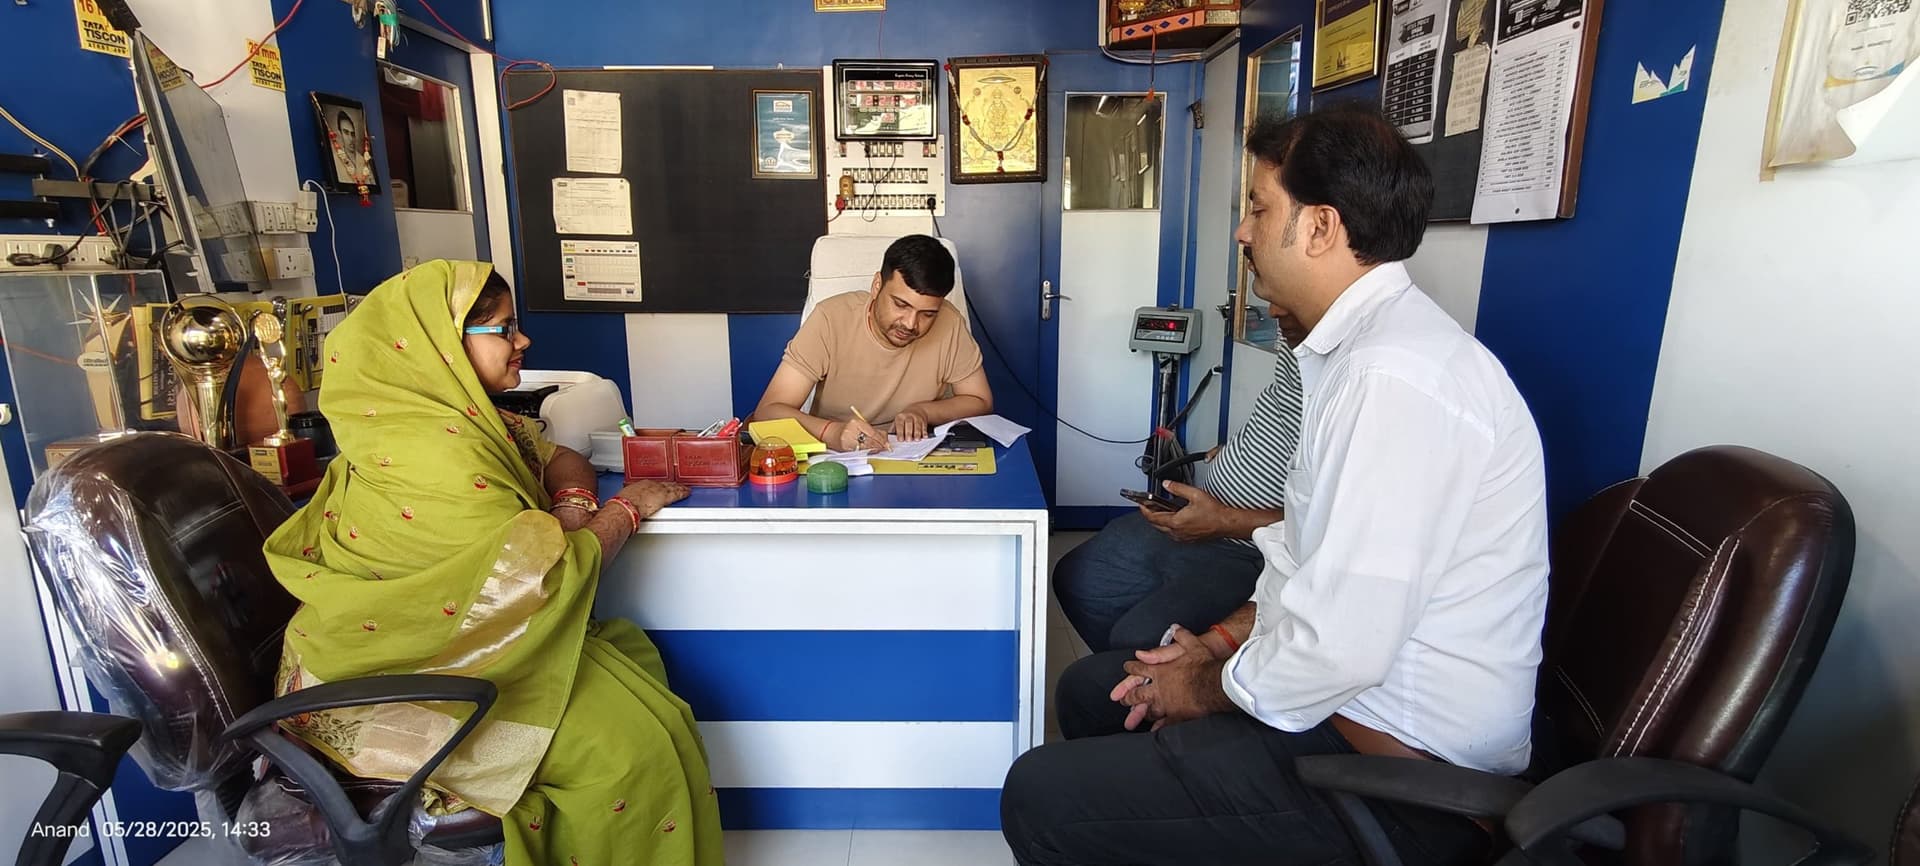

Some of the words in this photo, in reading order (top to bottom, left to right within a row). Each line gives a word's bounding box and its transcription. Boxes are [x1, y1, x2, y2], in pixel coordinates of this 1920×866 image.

[82, 20, 105, 30] TATA
[84, 28, 126, 45] TISCON
[252, 60, 267, 69] TATA
[253, 67, 282, 81] TISCON
